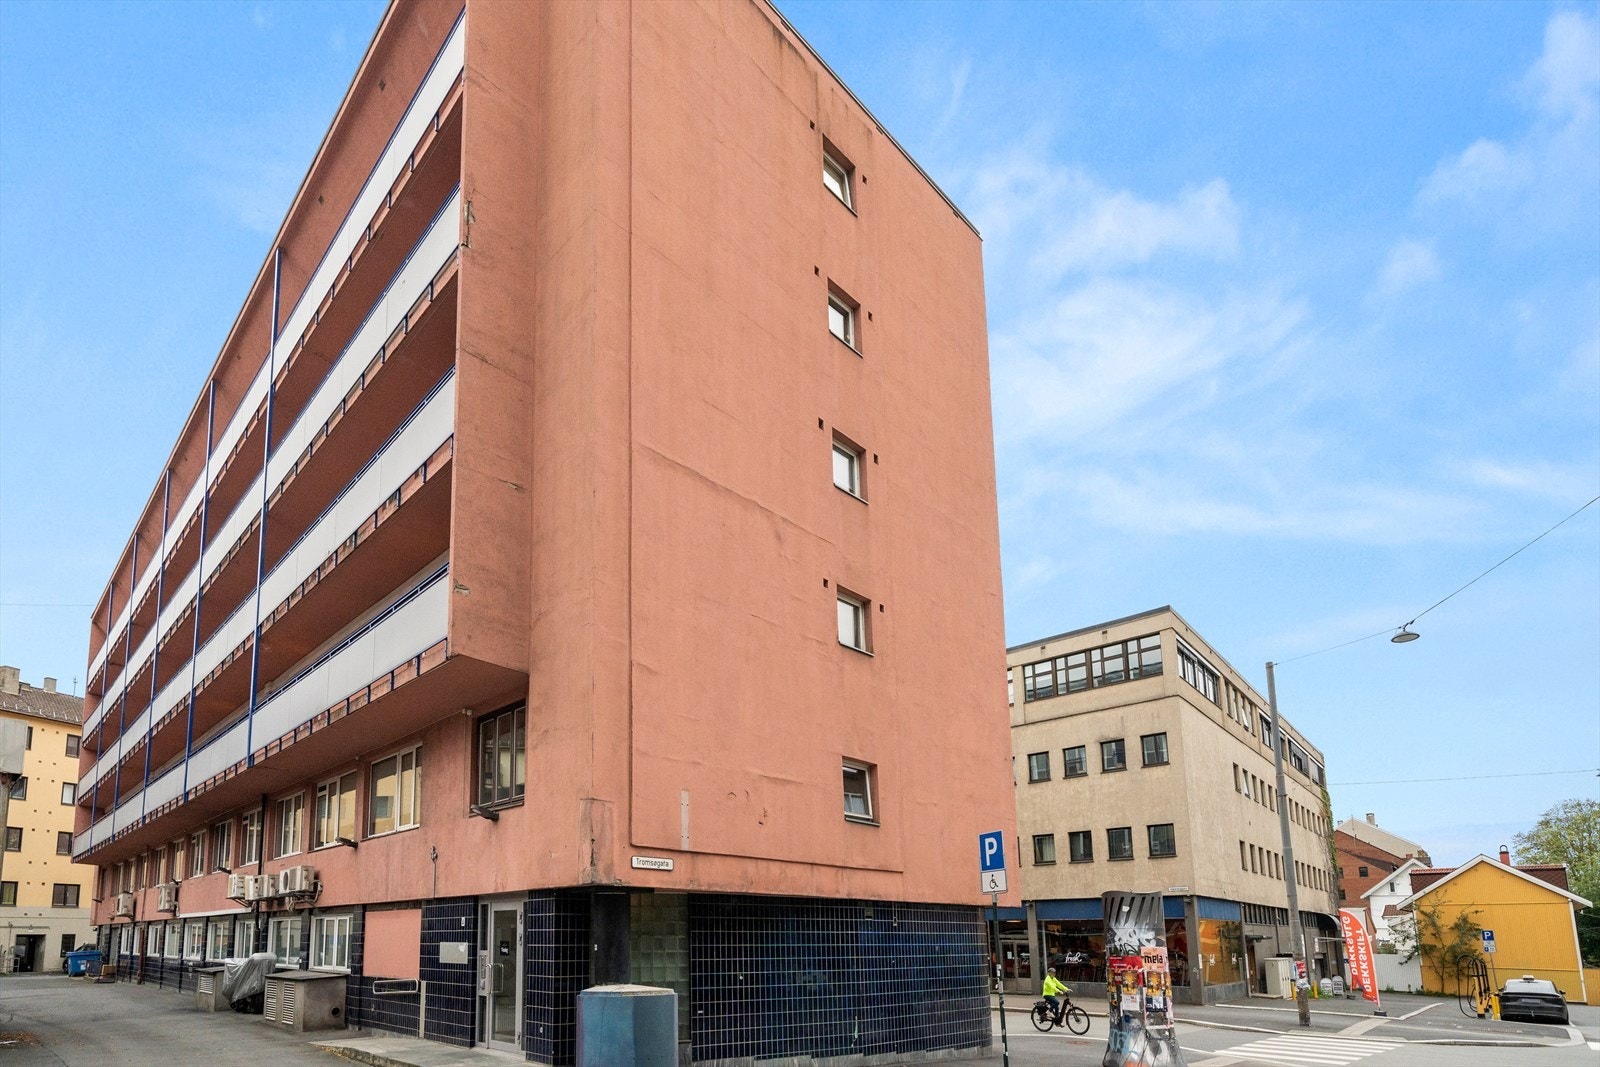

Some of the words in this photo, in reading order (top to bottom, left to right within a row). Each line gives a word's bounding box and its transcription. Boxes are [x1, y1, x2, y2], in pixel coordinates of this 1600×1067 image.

[985, 837, 998, 866] P
[1484, 931, 1491, 940] P
[1144, 954, 1163, 963] mela
